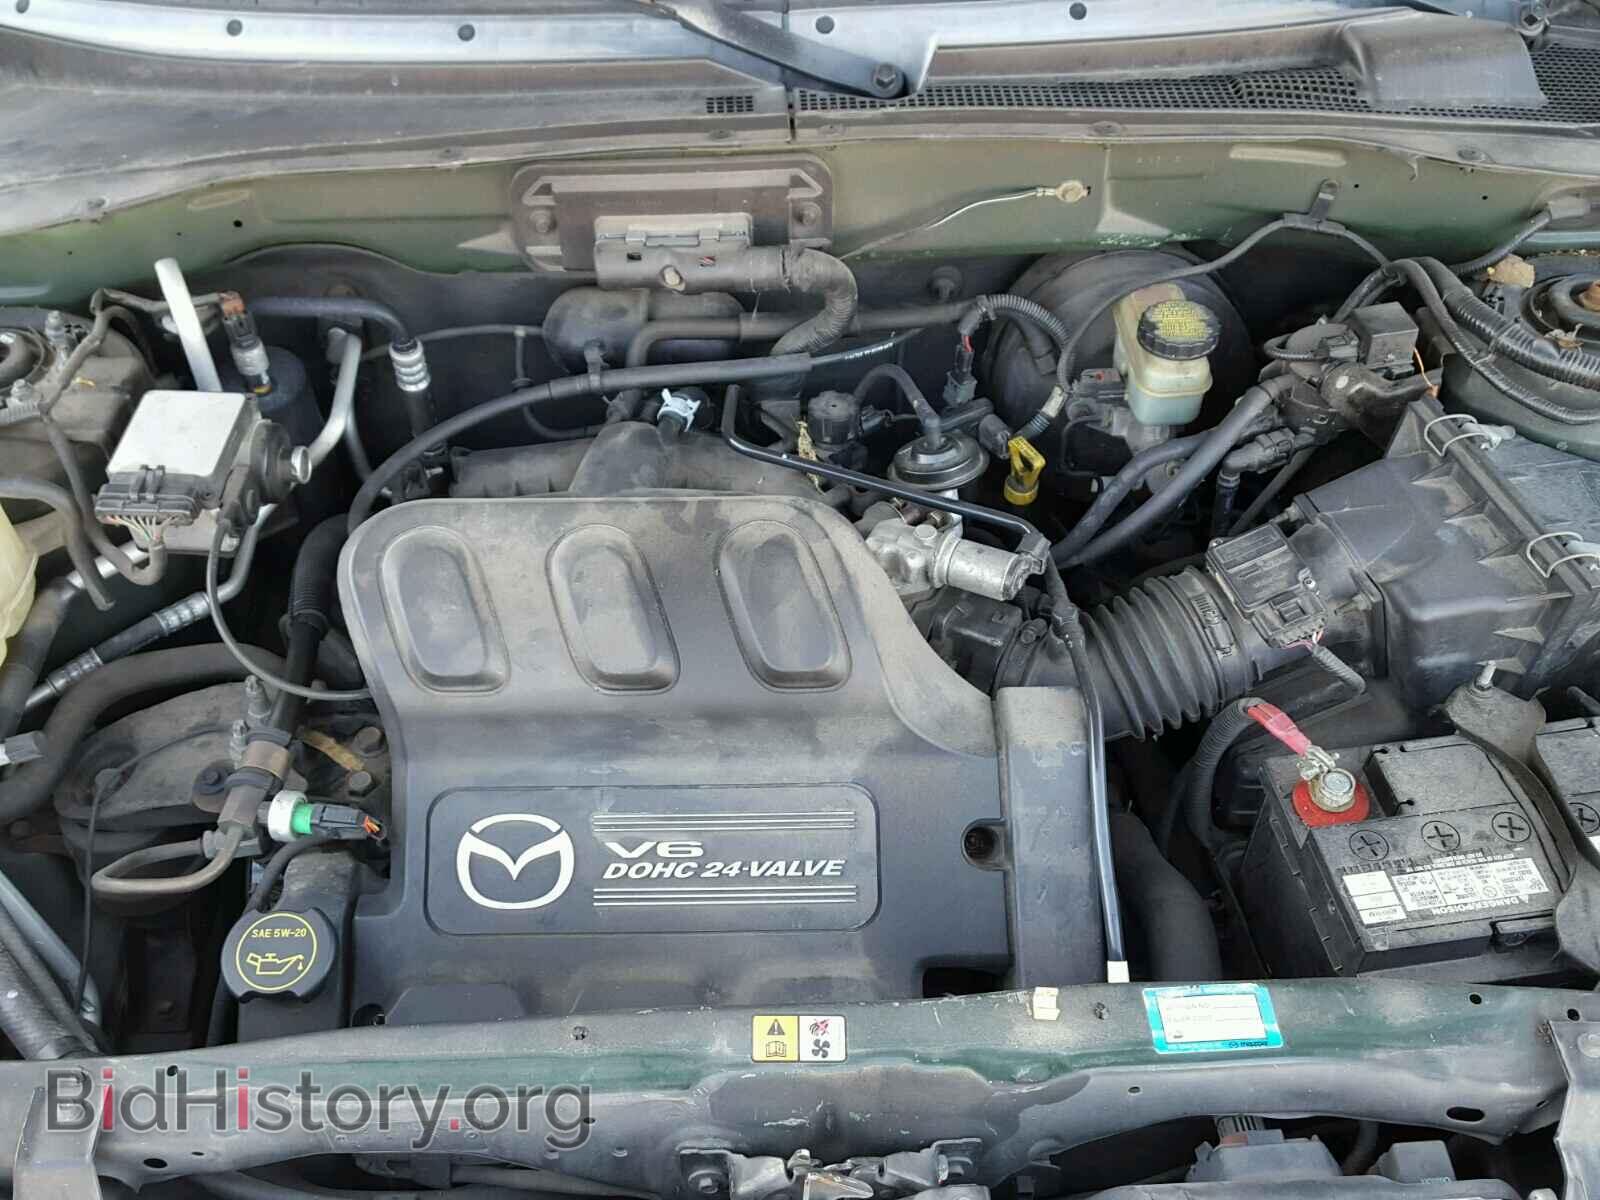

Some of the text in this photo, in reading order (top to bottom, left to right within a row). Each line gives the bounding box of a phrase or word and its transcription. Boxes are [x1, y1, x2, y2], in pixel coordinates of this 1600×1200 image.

[607, 840, 703, 858] V6
[603, 860, 846, 878] DOHC 24-VALVE
[252, 928, 306, 938] SAE 5W-20
